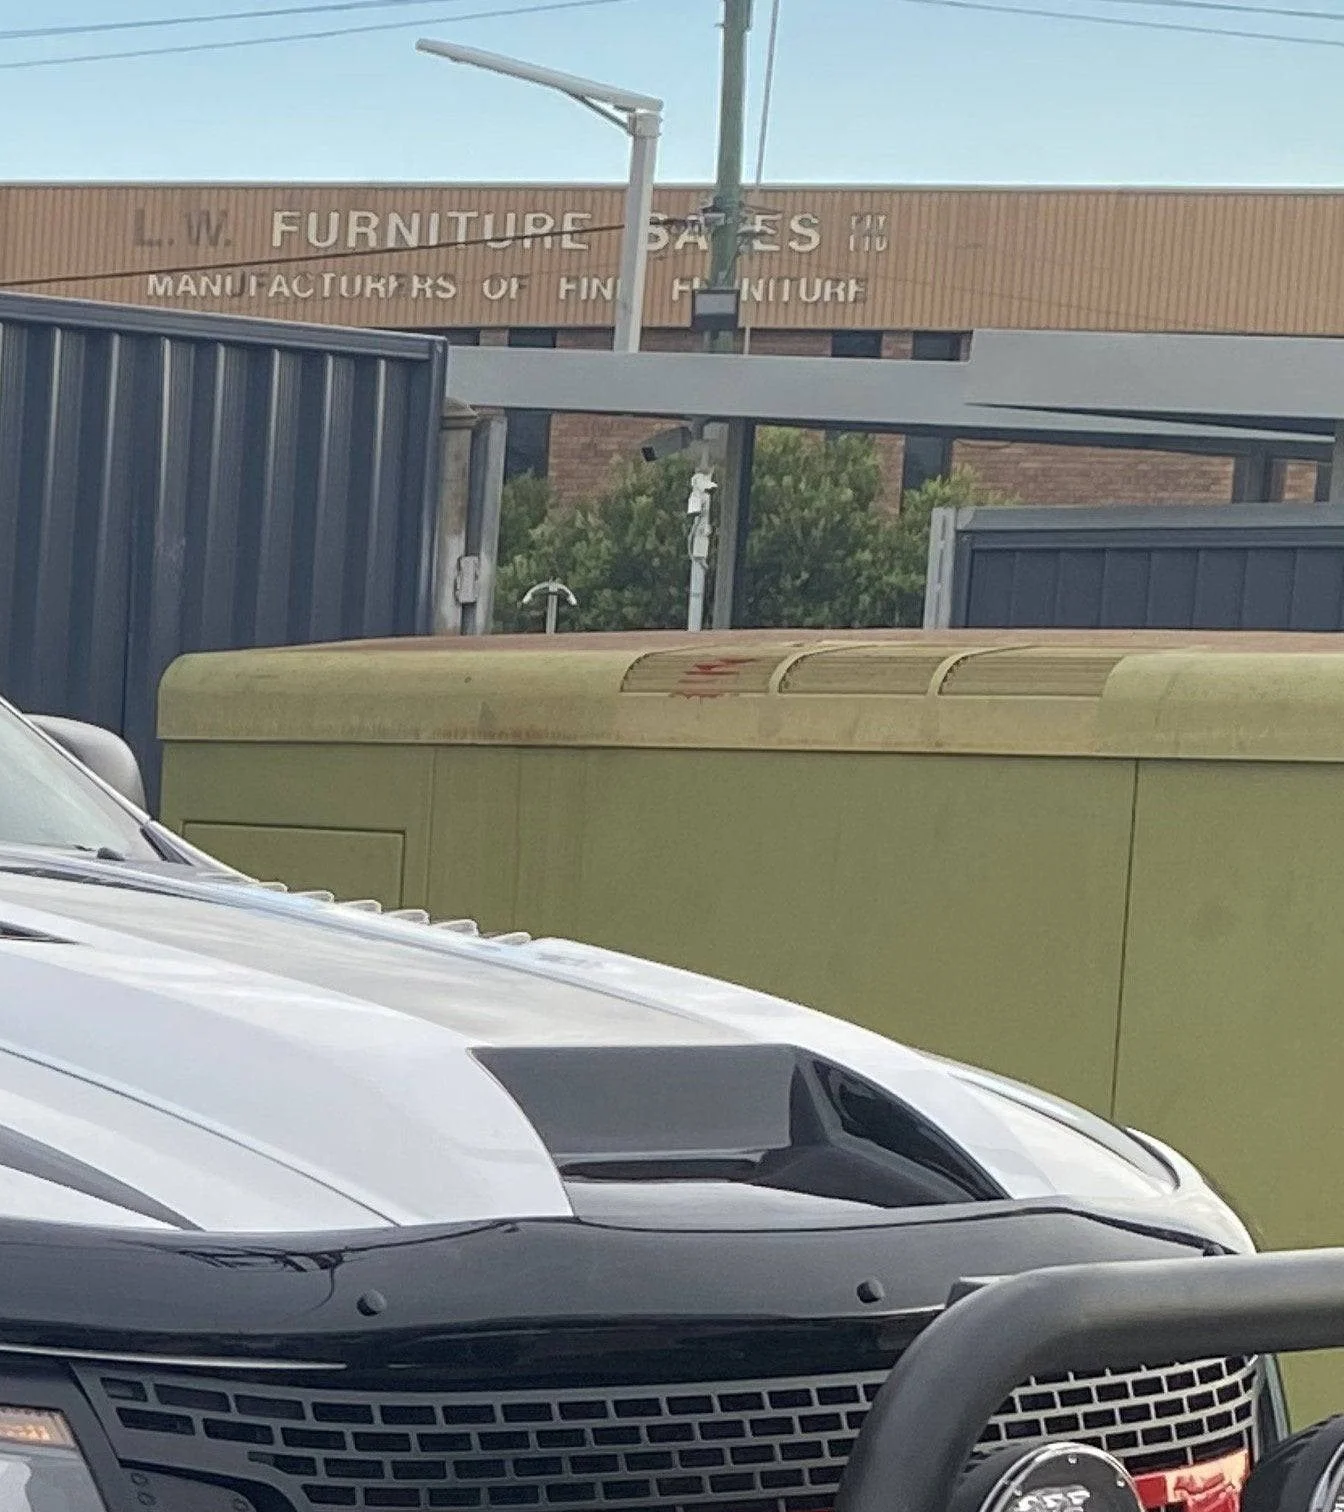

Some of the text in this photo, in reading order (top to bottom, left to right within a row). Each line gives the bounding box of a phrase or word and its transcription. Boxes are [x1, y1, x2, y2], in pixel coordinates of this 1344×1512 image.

[271, 209, 592, 250] FURNITURE
[643, 212, 821, 252] SAES
[482, 273, 529, 300] OF
[559, 275, 634, 301] FIN
[672, 276, 867, 302] FNITURE
